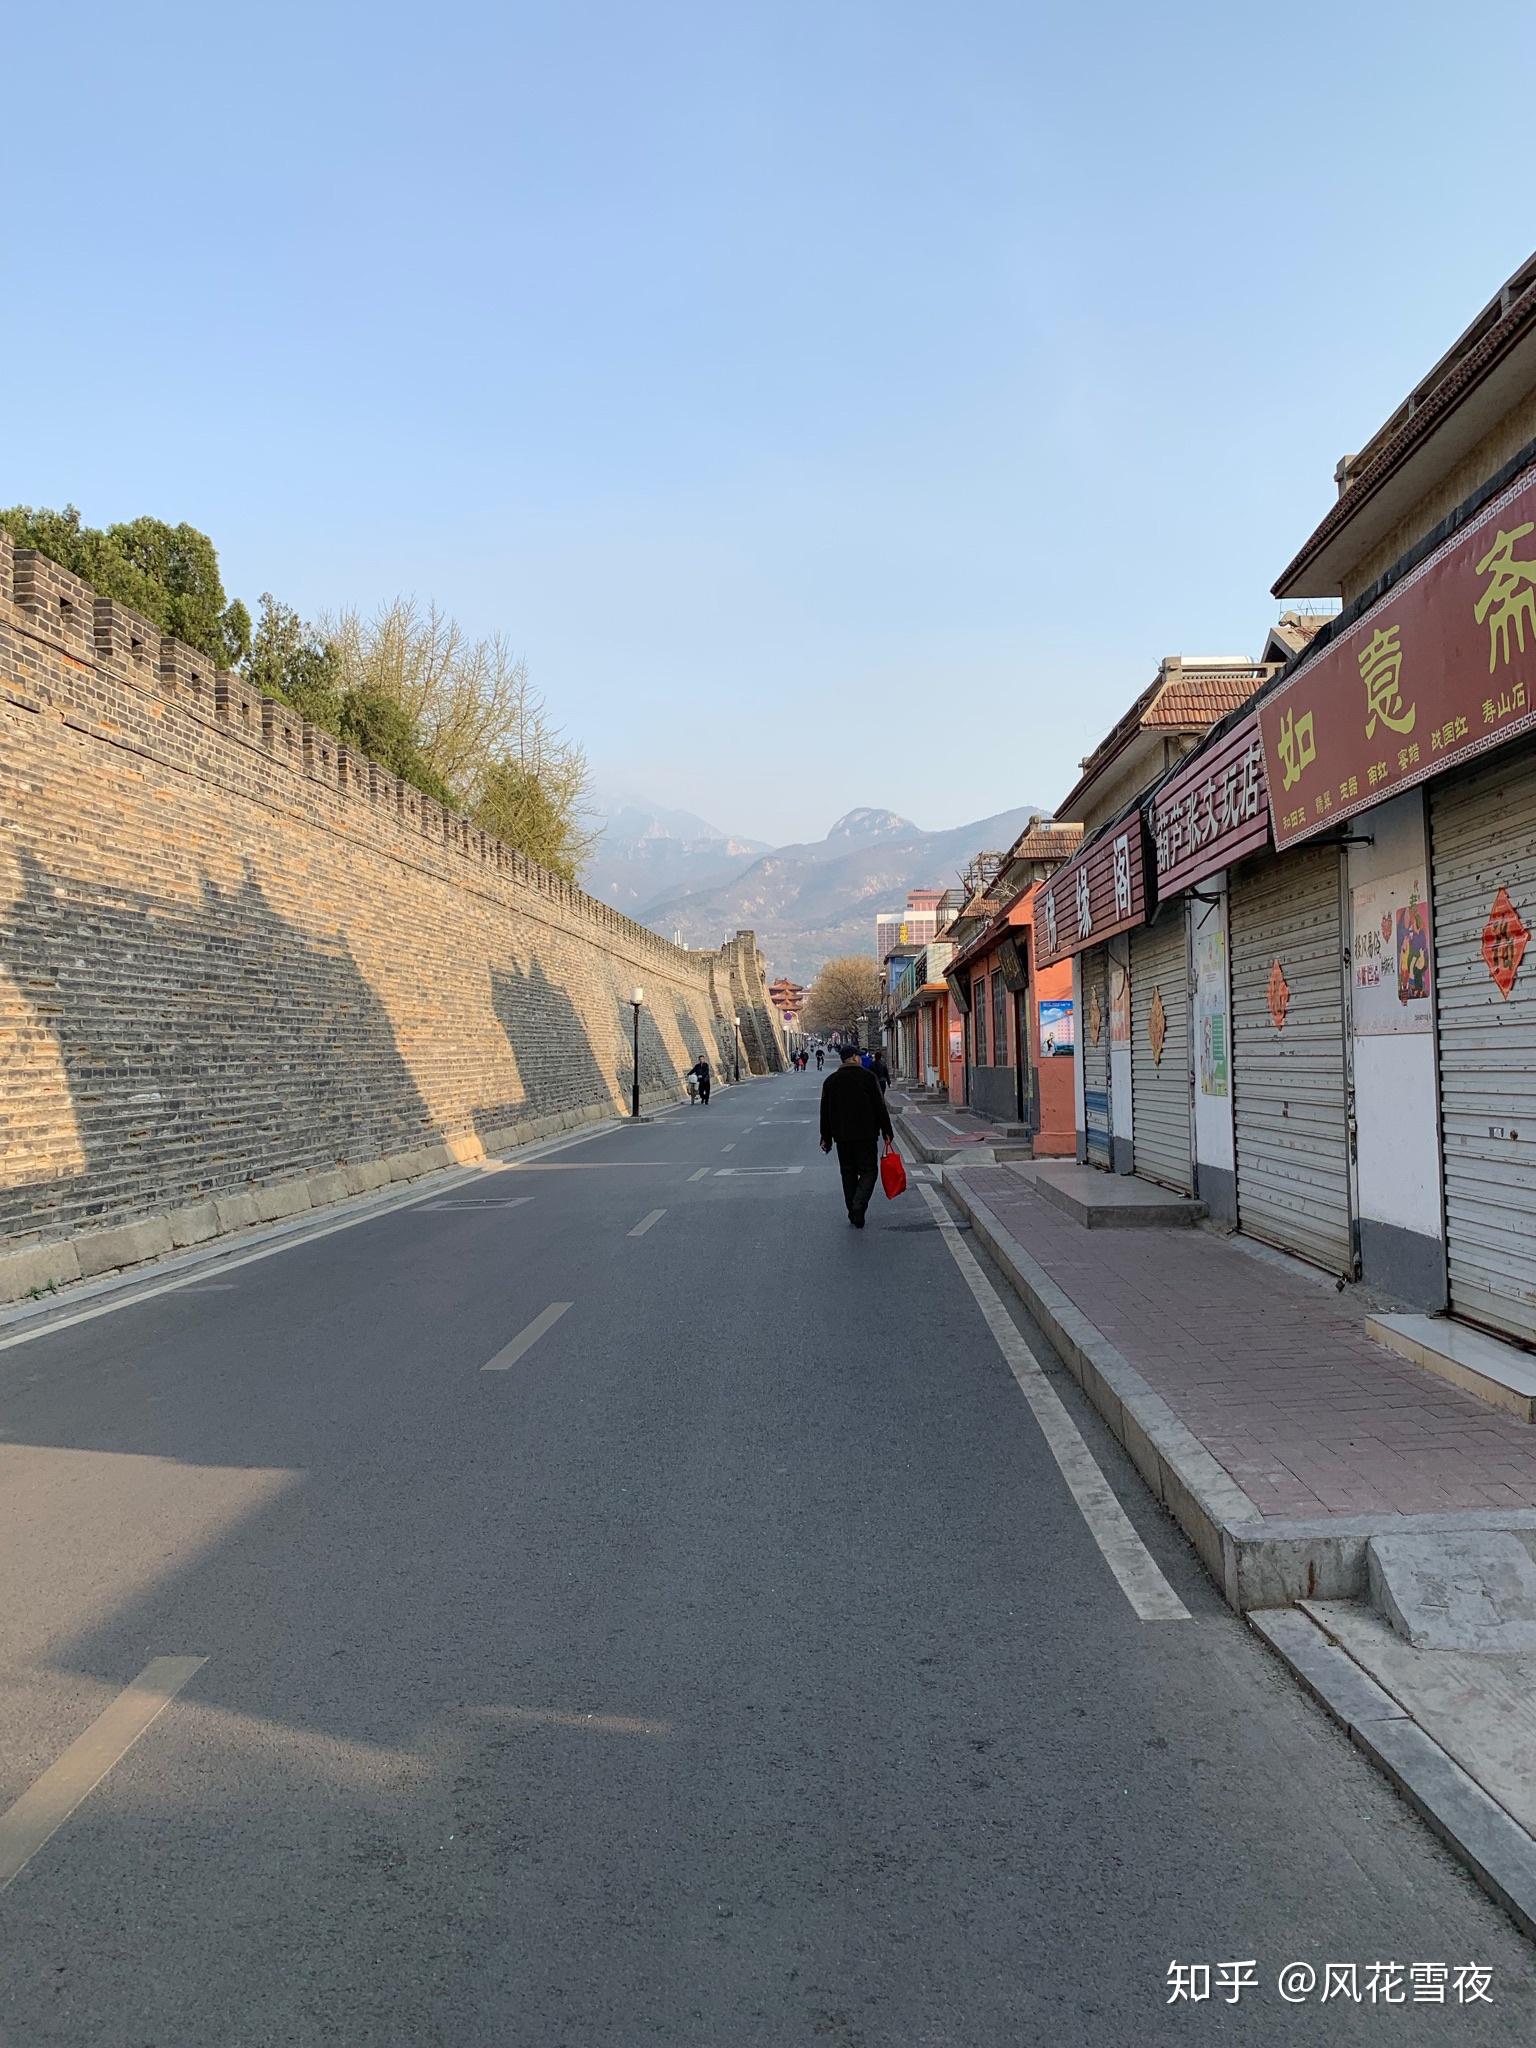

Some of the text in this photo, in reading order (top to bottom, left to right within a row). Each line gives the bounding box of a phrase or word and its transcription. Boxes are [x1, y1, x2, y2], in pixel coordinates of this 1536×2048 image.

[1277, 521, 1536, 791] 如意斋
[1156, 743, 1262, 871] 葫芦张文玩店
[1282, 807, 1307, 830] 和田玉
[1340, 775, 1359, 801] 玉器
[1367, 761, 1388, 785] 南红
[1431, 716, 1469, 751] 战国红
[1482, 682, 1526, 724] 寿山石
